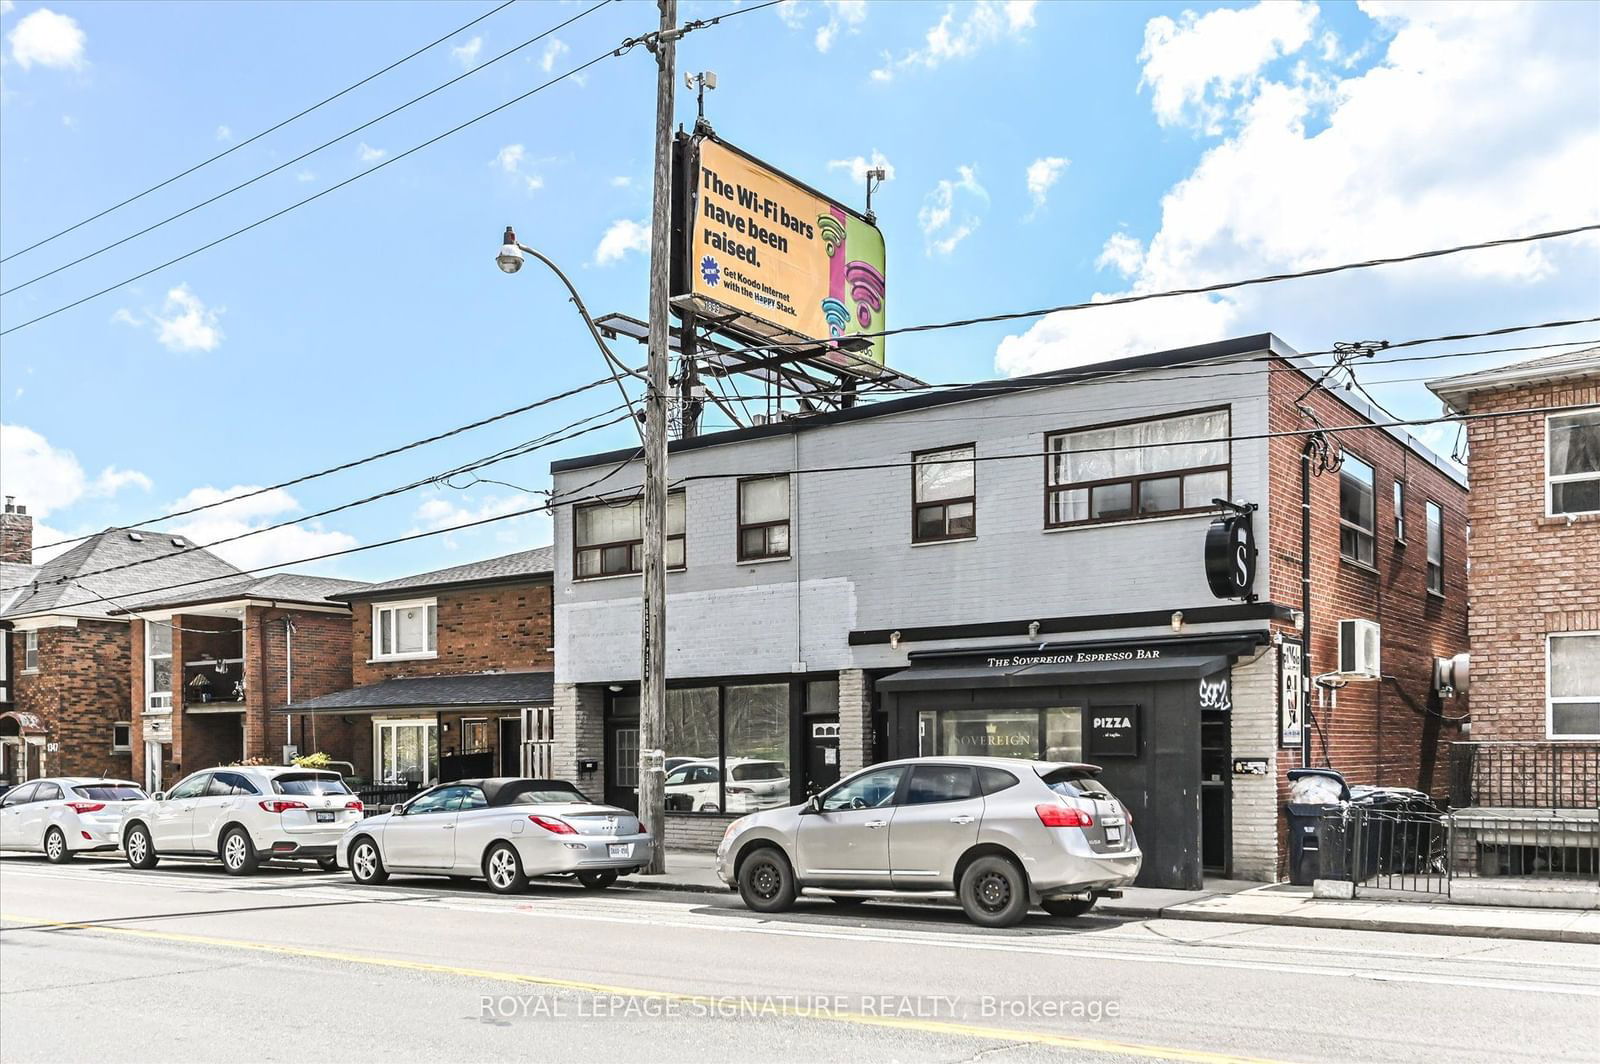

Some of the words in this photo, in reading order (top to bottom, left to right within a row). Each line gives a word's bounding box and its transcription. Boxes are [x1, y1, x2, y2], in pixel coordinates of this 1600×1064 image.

[702, 166, 734, 200] The
[737, 184, 777, 223] Wi-Fi
[781, 206, 813, 240] bars
[704, 196, 745, 233] have
[749, 217, 787, 253] been
[704, 228, 760, 268] raised.
[723, 267, 736, 279] Get
[737, 272, 761, 290] Koodo
[762, 283, 790, 302] Internet
[723, 280, 741, 293] with
[741, 287, 754, 298] the
[776, 300, 797, 317] Stack.
[1236, 545, 1247, 587] S
[987, 658, 1010, 668] THE
[1012, 654, 1073, 666] SOVEREIGN
[1077, 651, 1133, 663] ESPRESSO
[1136, 649, 1160, 659] BAR
[955, 735, 1031, 746] SOVEREIGN
[1093, 717, 1132, 729] PIZZA
